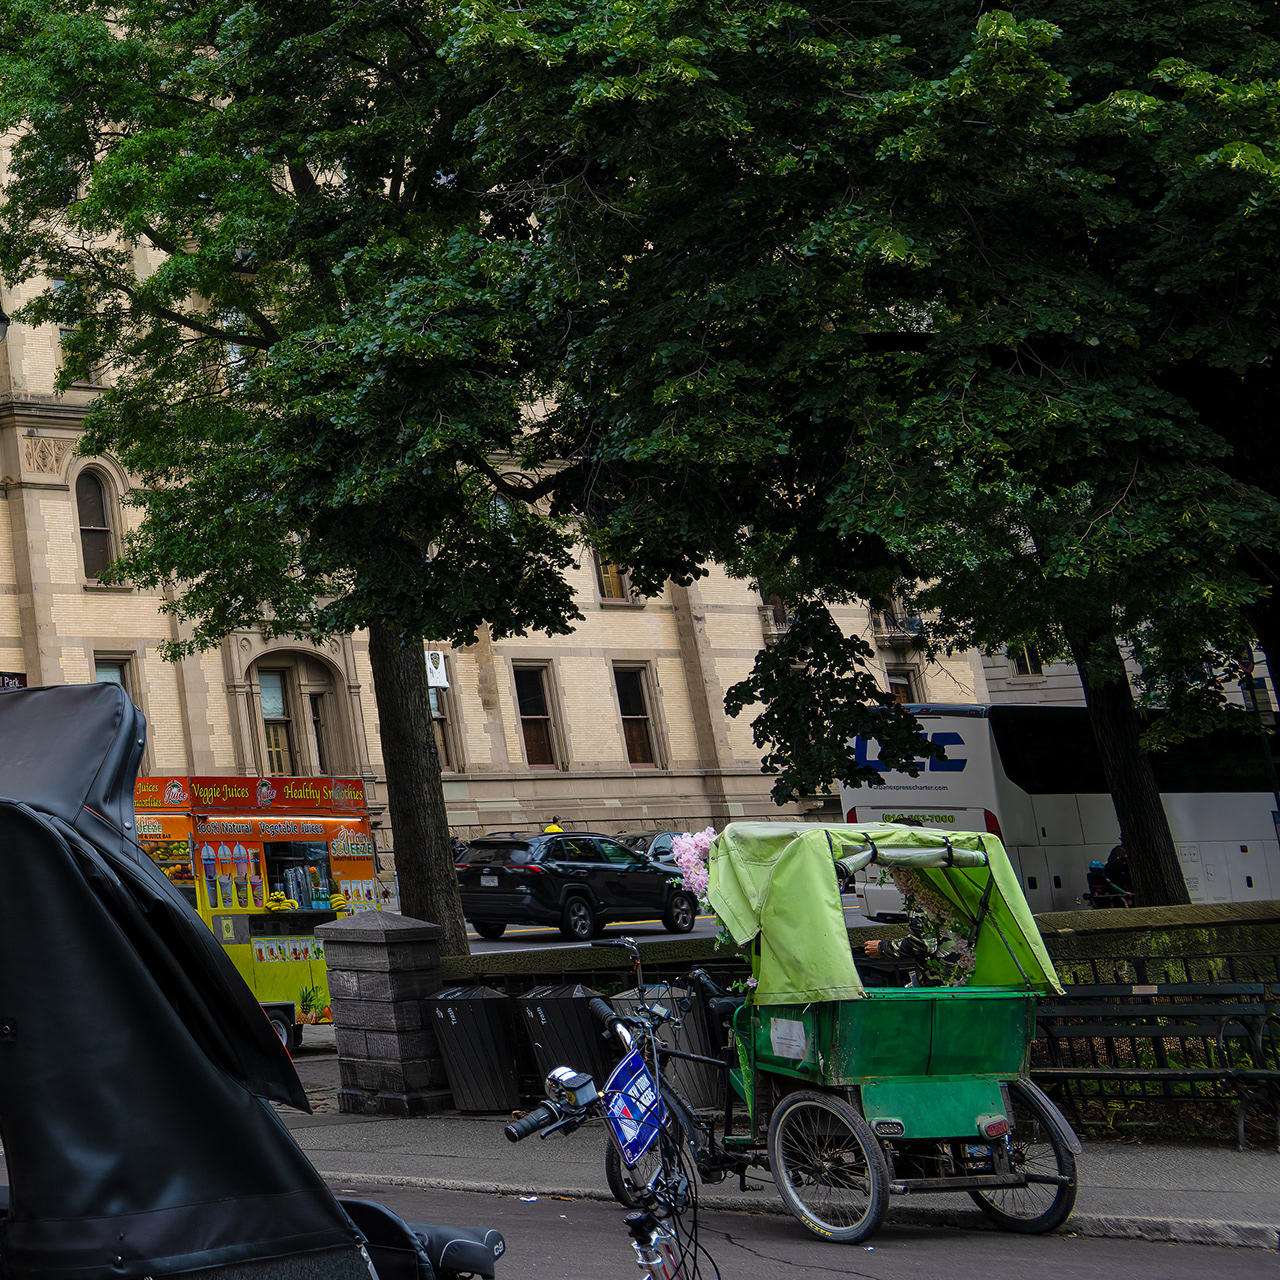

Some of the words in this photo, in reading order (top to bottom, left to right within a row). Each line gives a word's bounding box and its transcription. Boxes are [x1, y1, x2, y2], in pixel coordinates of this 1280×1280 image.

[4, 676, 20, 687] Park
[137, 782, 159, 794] Juices
[191, 783, 221, 805] Veggie
[222, 784, 249, 801] Juices
[283, 781, 320, 806] Healthy
[136, 824, 162, 834] UEEZE
[197, 822, 219, 834] 100%
[221, 821, 252, 834] Natural
[258, 821, 299, 837] Vegetable
[300, 821, 324, 834] Juices
[447, 1007, 457, 1025] Trash
[537, 1007, 547, 1025] Trash
